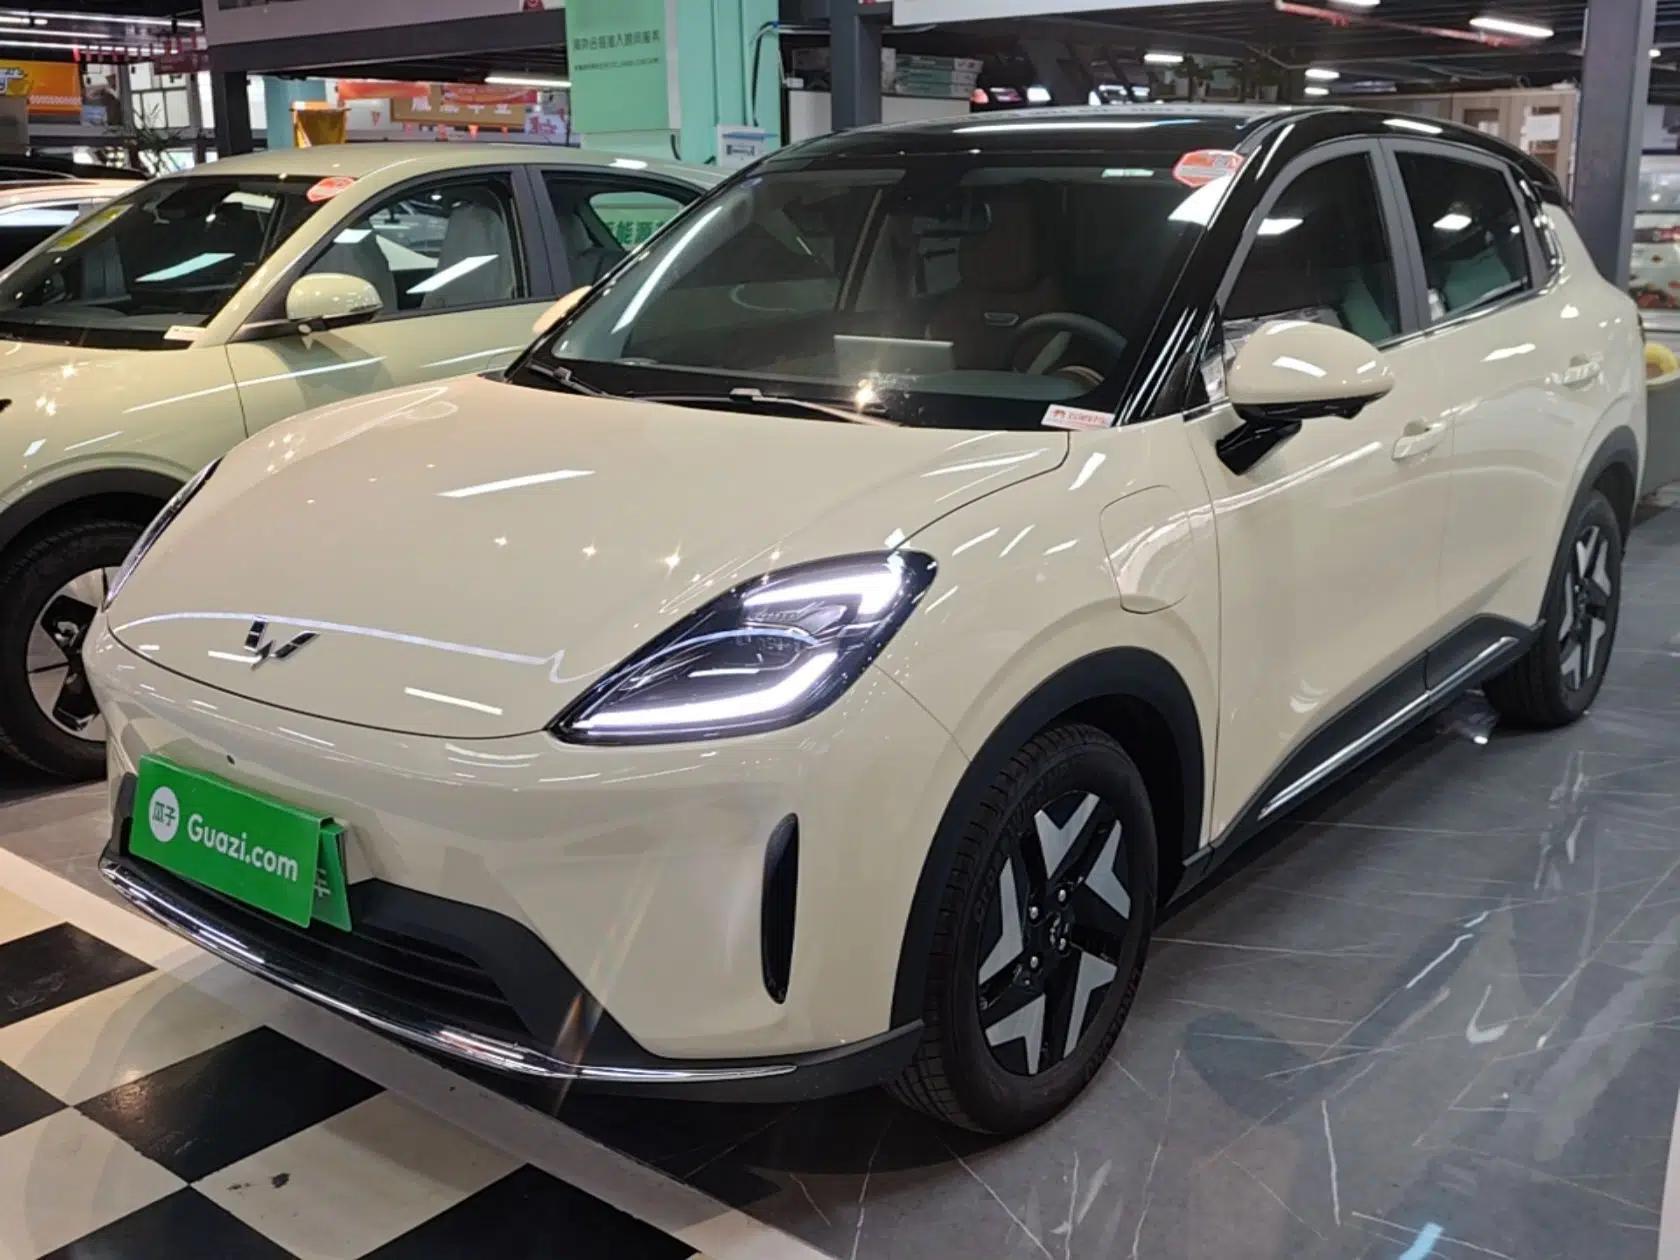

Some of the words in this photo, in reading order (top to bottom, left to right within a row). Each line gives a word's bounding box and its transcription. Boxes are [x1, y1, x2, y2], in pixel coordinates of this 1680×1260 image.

[606, 220, 666, 245] 能源
[152, 801, 177, 827] 瓜子
[187, 813, 299, 882] Guazi.com
